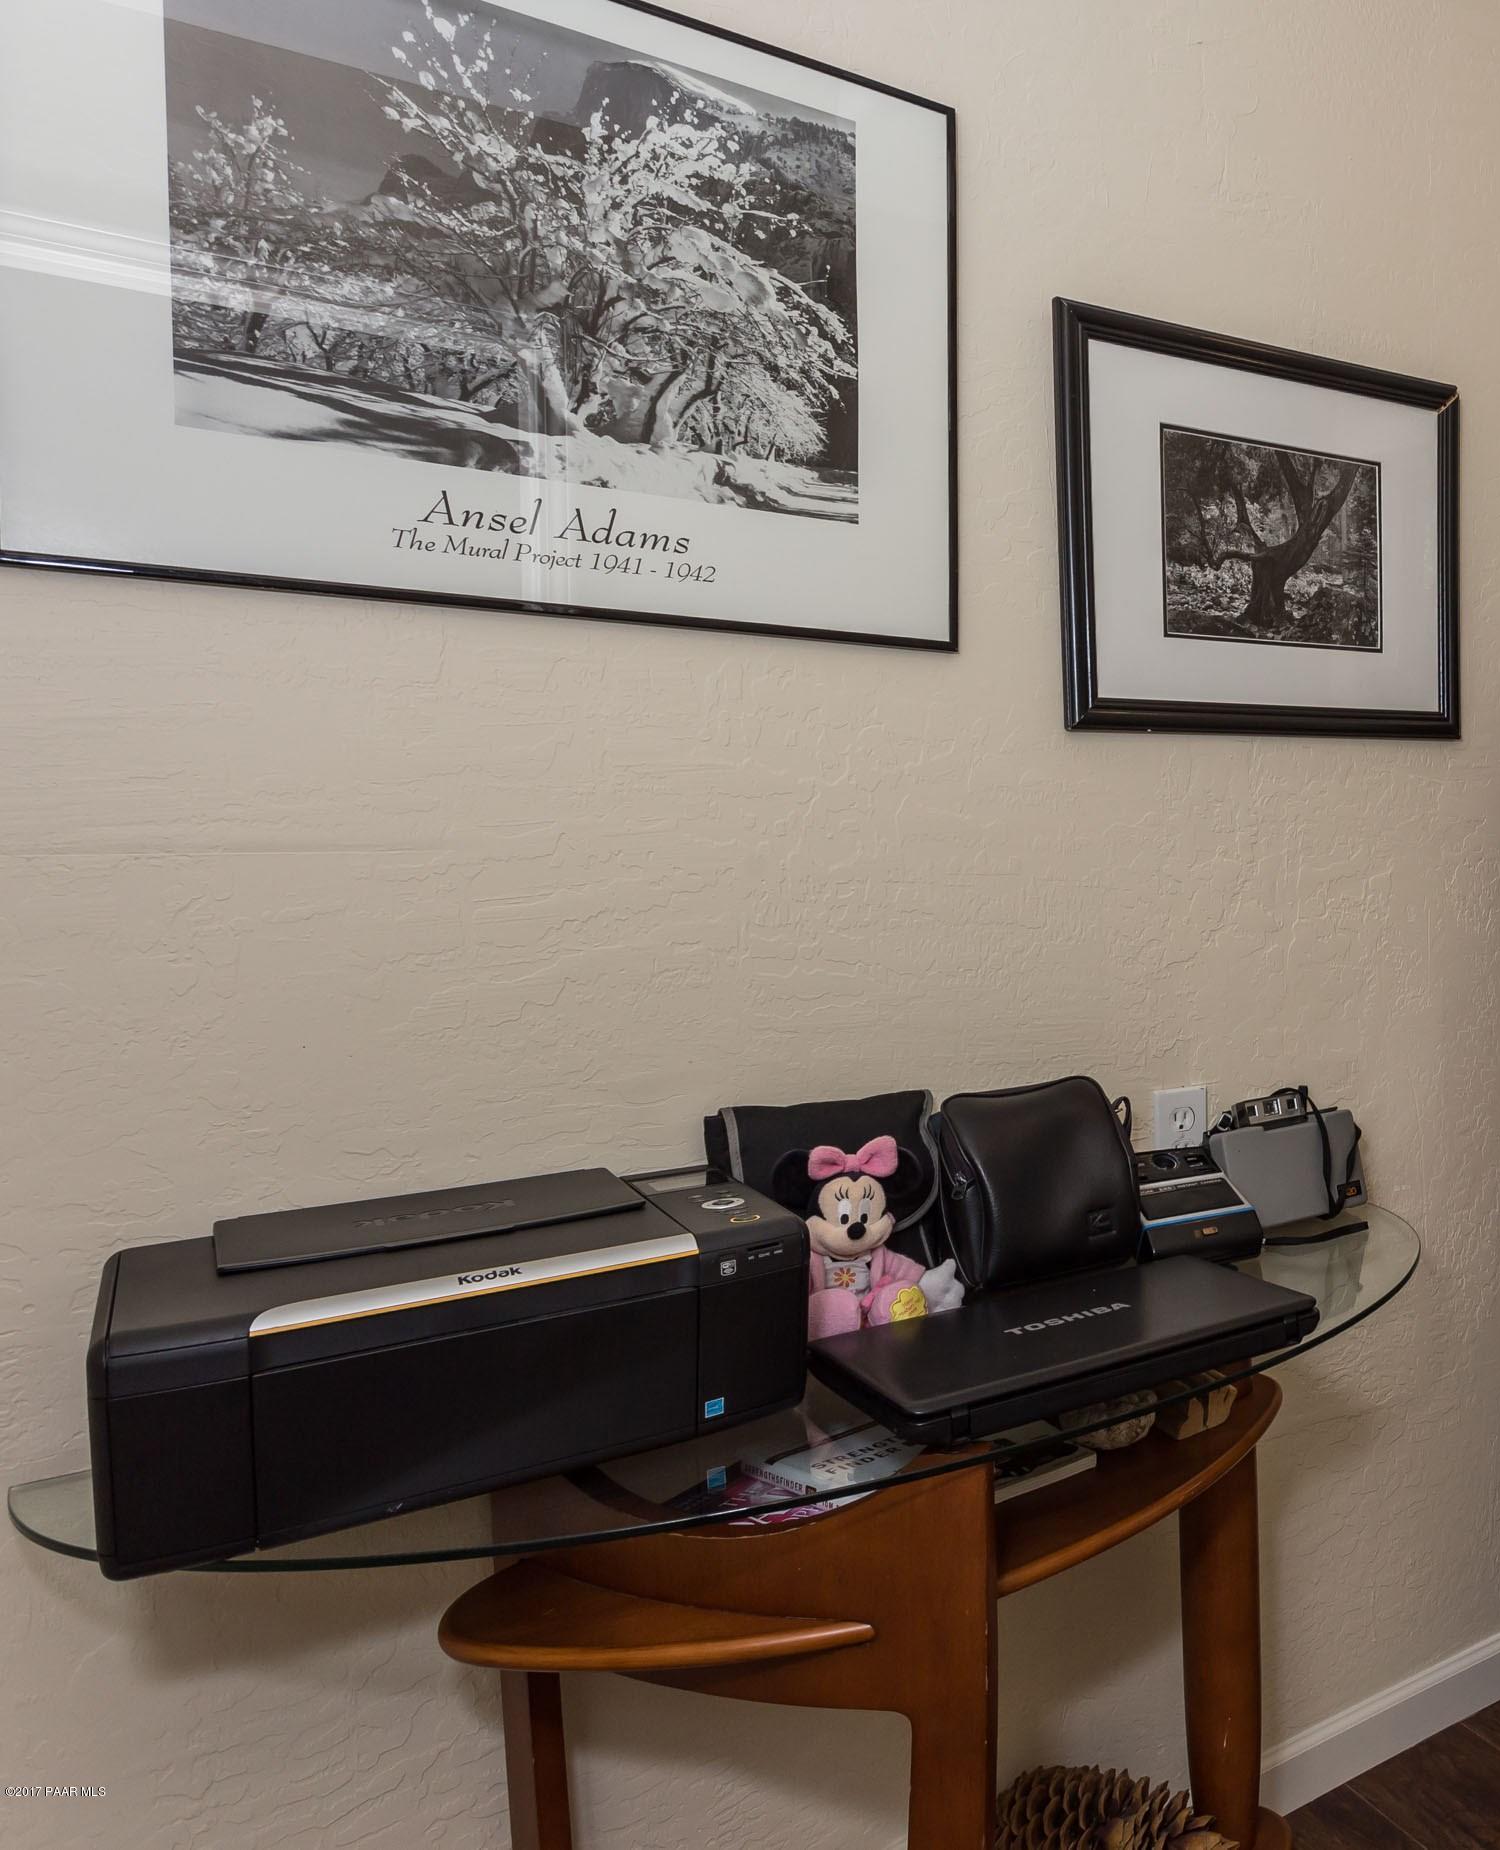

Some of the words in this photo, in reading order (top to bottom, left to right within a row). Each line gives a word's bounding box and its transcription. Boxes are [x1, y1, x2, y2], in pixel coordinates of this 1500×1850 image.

[417, 489, 543, 536] Ansel
[554, 508, 691, 554] Adams
[391, 527, 436, 553] The
[443, 534, 508, 561] Mural
[514, 542, 583, 571] Project
[592, 553, 643, 576] 1941
[665, 561, 718, 583] 1942
[457, 1266, 524, 1285] Kodak
[1003, 1302, 1132, 1335] TOSHIBA
